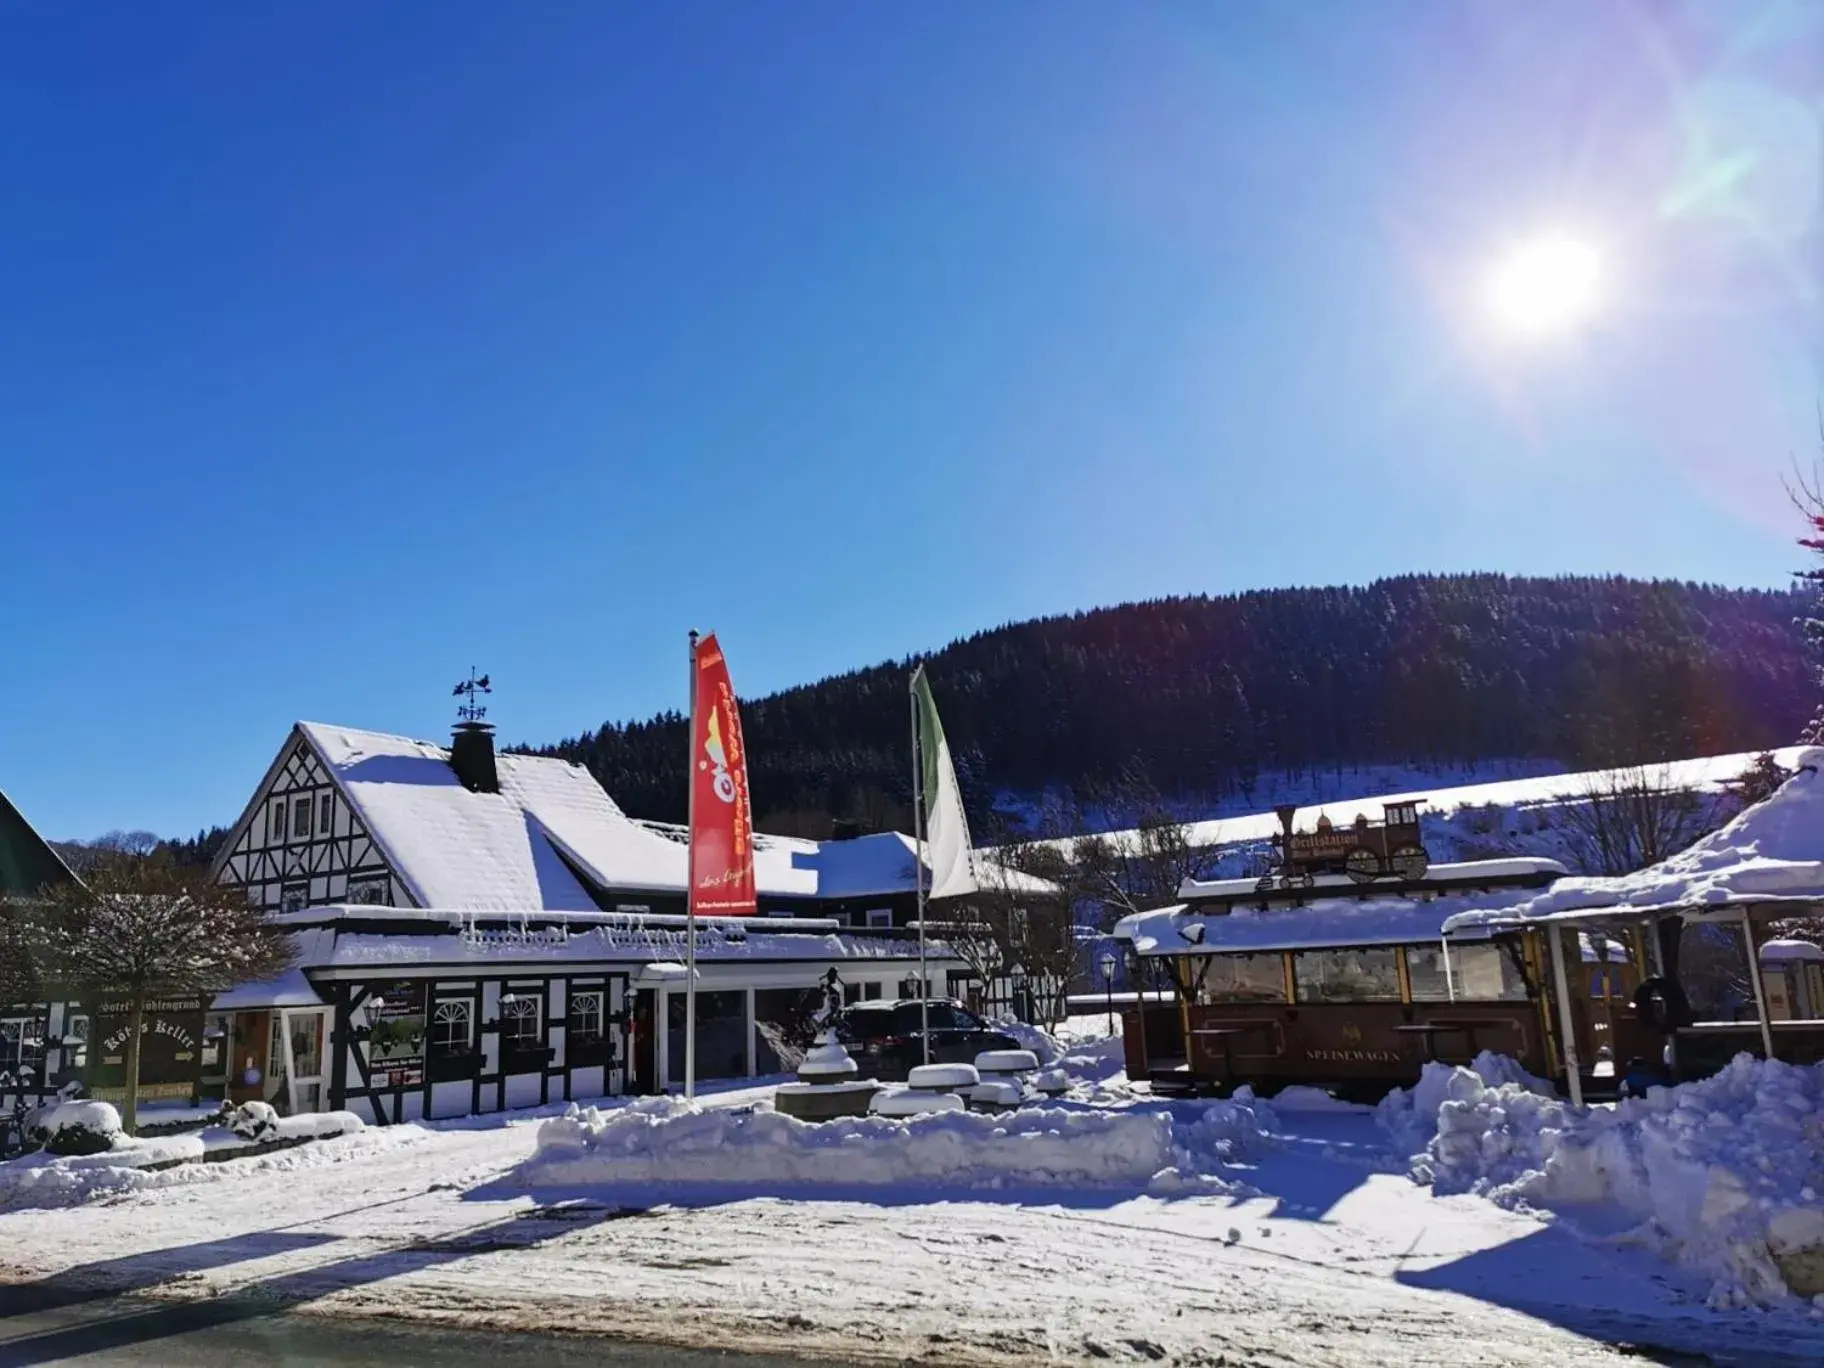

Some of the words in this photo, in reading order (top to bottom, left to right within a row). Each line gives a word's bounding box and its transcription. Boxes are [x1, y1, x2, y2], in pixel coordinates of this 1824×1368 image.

[130, 999, 201, 1013] ühlengrund
[154, 1019, 195, 1049] Keller
[1304, 1048, 1400, 1062] SPEISEWAGEN
